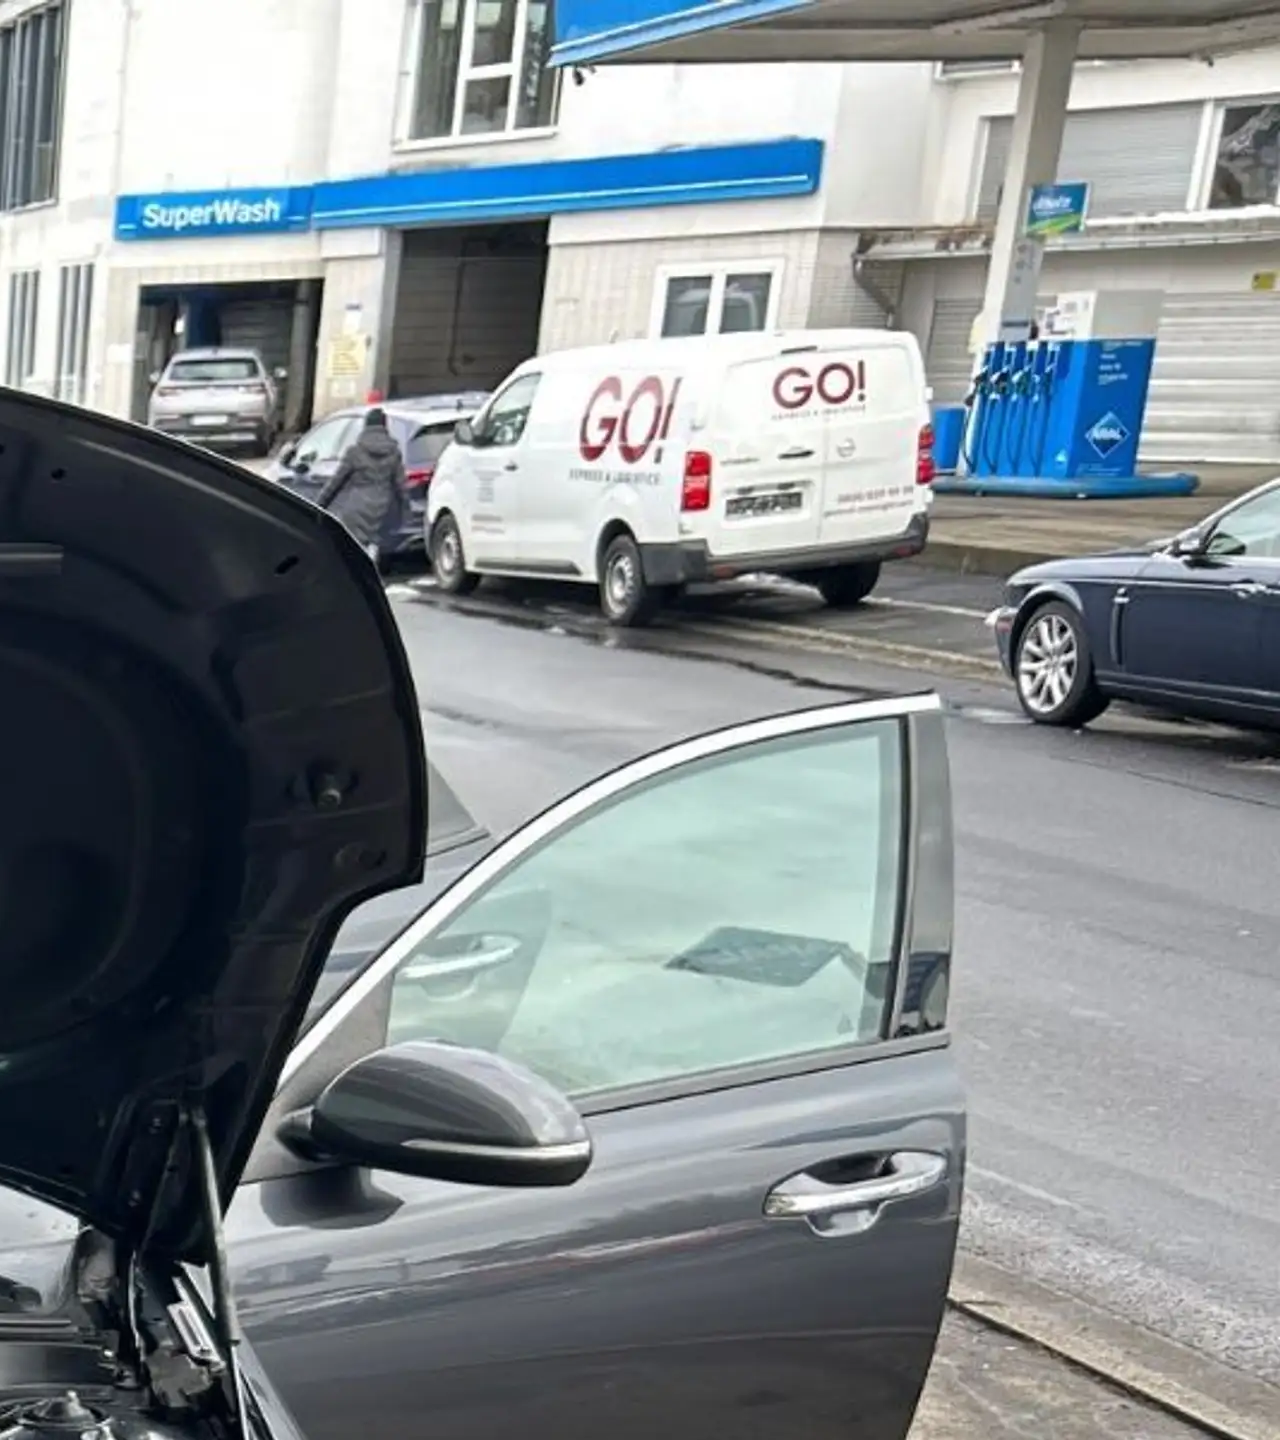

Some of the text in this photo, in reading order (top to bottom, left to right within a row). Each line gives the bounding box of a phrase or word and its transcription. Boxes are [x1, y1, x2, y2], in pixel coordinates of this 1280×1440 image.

[142, 198, 281, 231] SuperWash
[772, 359, 866, 410] GO!
[579, 375, 683, 465] GO!
